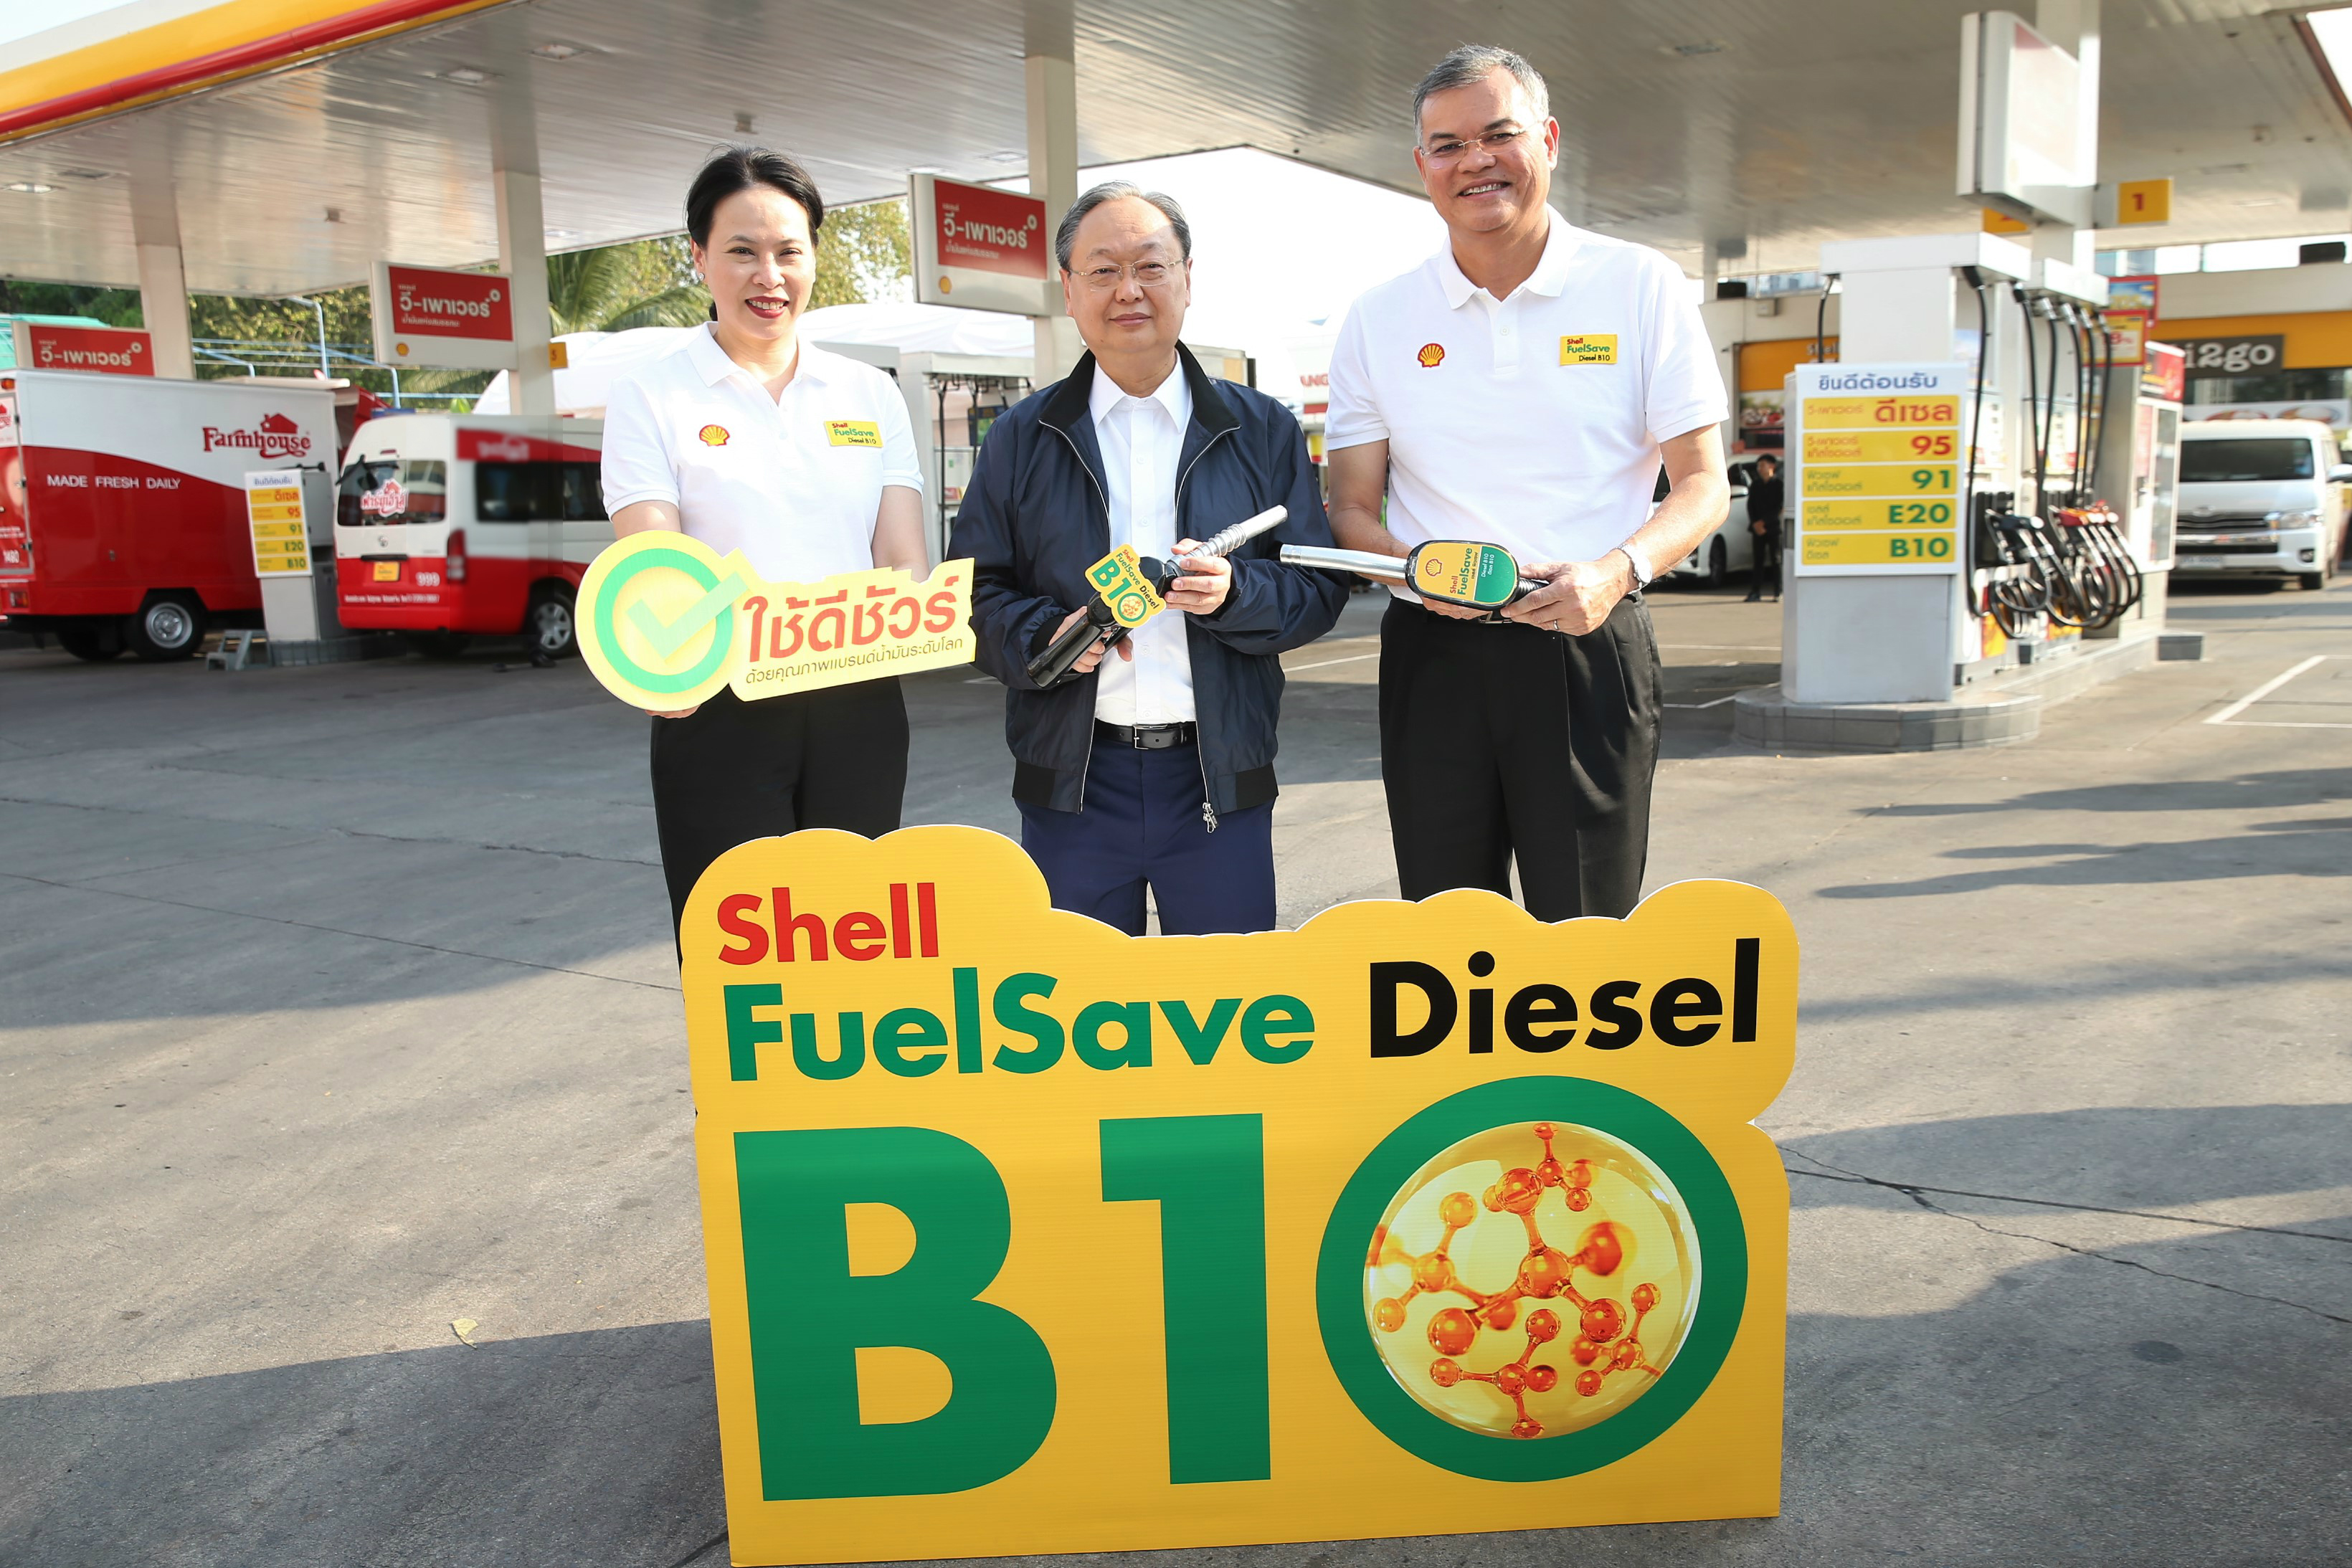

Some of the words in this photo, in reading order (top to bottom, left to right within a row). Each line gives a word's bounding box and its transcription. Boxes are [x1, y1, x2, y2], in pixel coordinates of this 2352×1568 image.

[2132, 192, 2145, 212] 1
[944, 212, 1038, 250] วี-เพาเวอร์
[399, 288, 501, 318] วี-เพาเวอร์
[41, 341, 143, 366] วี-เพาเวอร์
[1567, 343, 1611, 353] FuelSave
[2184, 341, 2277, 372] i2go
[1818, 372, 1938, 391] ยินดีต้อนรับ
[1874, 399, 1953, 422] ดีเซล
[202, 427, 312, 459] Farmhouse
[834, 428, 874, 437] FuelSave
[1911, 435, 1952, 456] 95
[47, 475, 88, 488] MADE
[95, 475, 140, 489] FRESH
[146, 477, 181, 489] DAILY
[1912, 470, 1950, 489] 91
[287, 507, 300, 518] 95
[1888, 503, 1950, 523] E20
[290, 523, 303, 534] 91
[285, 541, 304, 551] E20
[1122, 549, 1134, 563] Shell
[1890, 538, 1950, 557] B10
[287, 558, 306, 569] B10
[1457, 548, 1472, 594] FuelSave
[1091, 559, 1147, 622] B10
[1116, 553, 1140, 586] FuelSave
[1139, 585, 1160, 609] Diesel
[742, 575, 959, 662] ใช้ดีชัวร์
[746, 637, 962, 684] ด้วยคุณภาพแบรนด์น้ำมันระดับโลก
[717, 882, 939, 966] Shell
[723, 967, 1315, 1082] FuelSave
[1370, 938, 1760, 1058] Diesel
[734, 1075, 1748, 1501] B10
